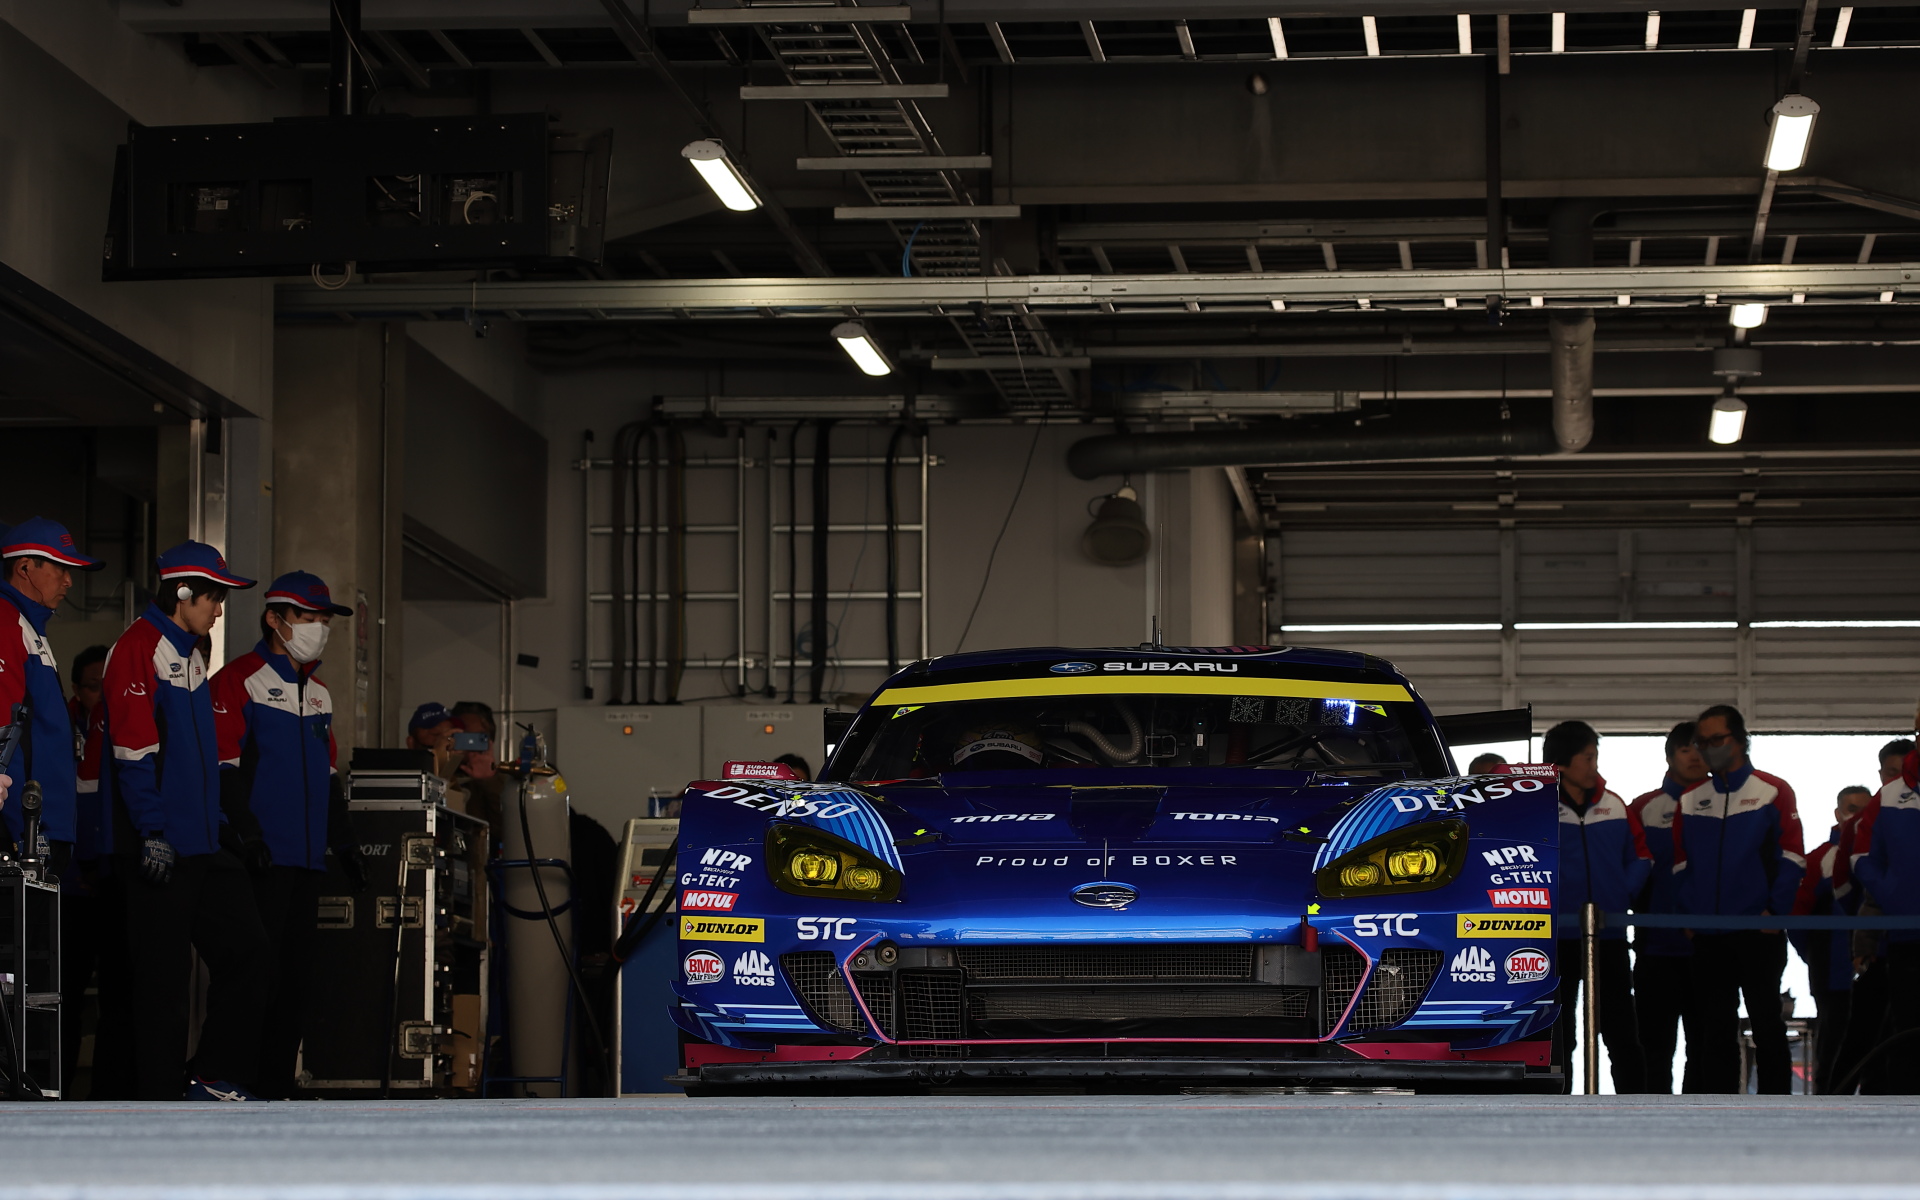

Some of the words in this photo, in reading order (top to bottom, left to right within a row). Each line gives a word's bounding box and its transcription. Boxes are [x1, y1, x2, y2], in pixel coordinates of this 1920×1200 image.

[1103, 662, 1238, 673] SUBARU
[987, 742, 1022, 752] SUBARU
[703, 786, 859, 818] DENSO
[1390, 779, 1544, 812] DENSO
[700, 848, 752, 872] NPR
[976, 855, 1069, 867] Proud
[1087, 855, 1115, 867] of
[1132, 855, 1237, 867] BOXER
[1482, 845, 1539, 867] NPR
[681, 873, 740, 888] G-TEKT
[1490, 871, 1552, 885] G-TEKT
[683, 892, 733, 910] MOTUL
[1493, 890, 1548, 906] MOTUL
[695, 922, 758, 935] DUNLOP
[797, 916, 857, 940] STC
[1353, 913, 1420, 937] STC
[1477, 920, 1546, 931] DUNLOP
[688, 958, 719, 974] BMC
[1511, 958, 1545, 972] BMC
[690, 973, 704, 981] Air
[733, 976, 775, 987] TOOLS
[1450, 972, 1496, 982] TOOLS
[1513, 970, 1528, 979] Air
